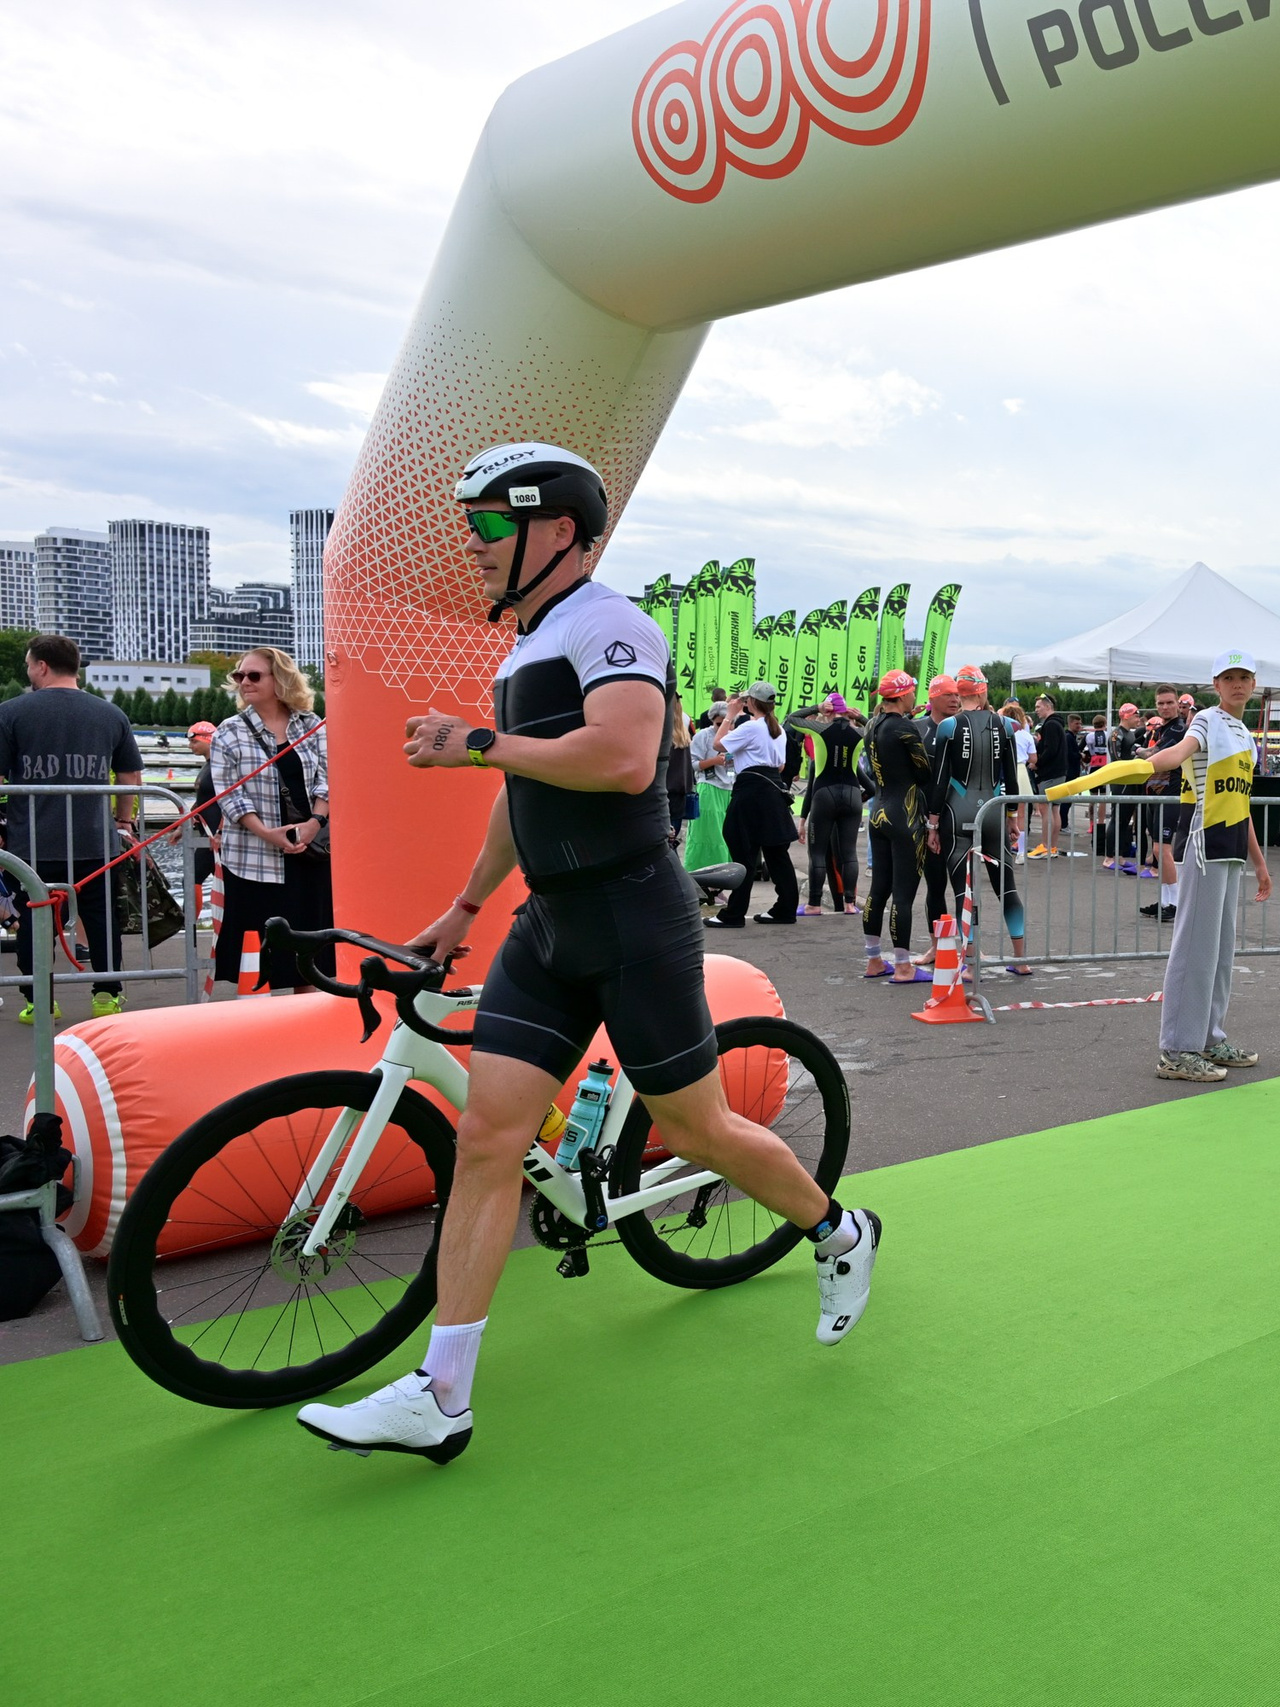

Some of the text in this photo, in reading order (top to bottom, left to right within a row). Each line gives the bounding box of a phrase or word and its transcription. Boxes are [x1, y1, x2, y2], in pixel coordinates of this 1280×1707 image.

[482, 450, 536, 475] RUDY
[514, 494, 537, 503] 1080
[728, 610, 740, 676] МОСКОВСКИЙ
[738, 647, 750, 677] СПОРТ
[755, 658, 767, 681] ier
[829, 653, 838, 678] сбп
[857, 645, 867, 672] сбп
[774, 655, 789, 707] Haier
[798, 655, 816, 709] Haier
[432, 723, 455, 751] 1080
[962, 727, 971, 759] HUUB
[22, 753, 109, 780] BAD IDEA
